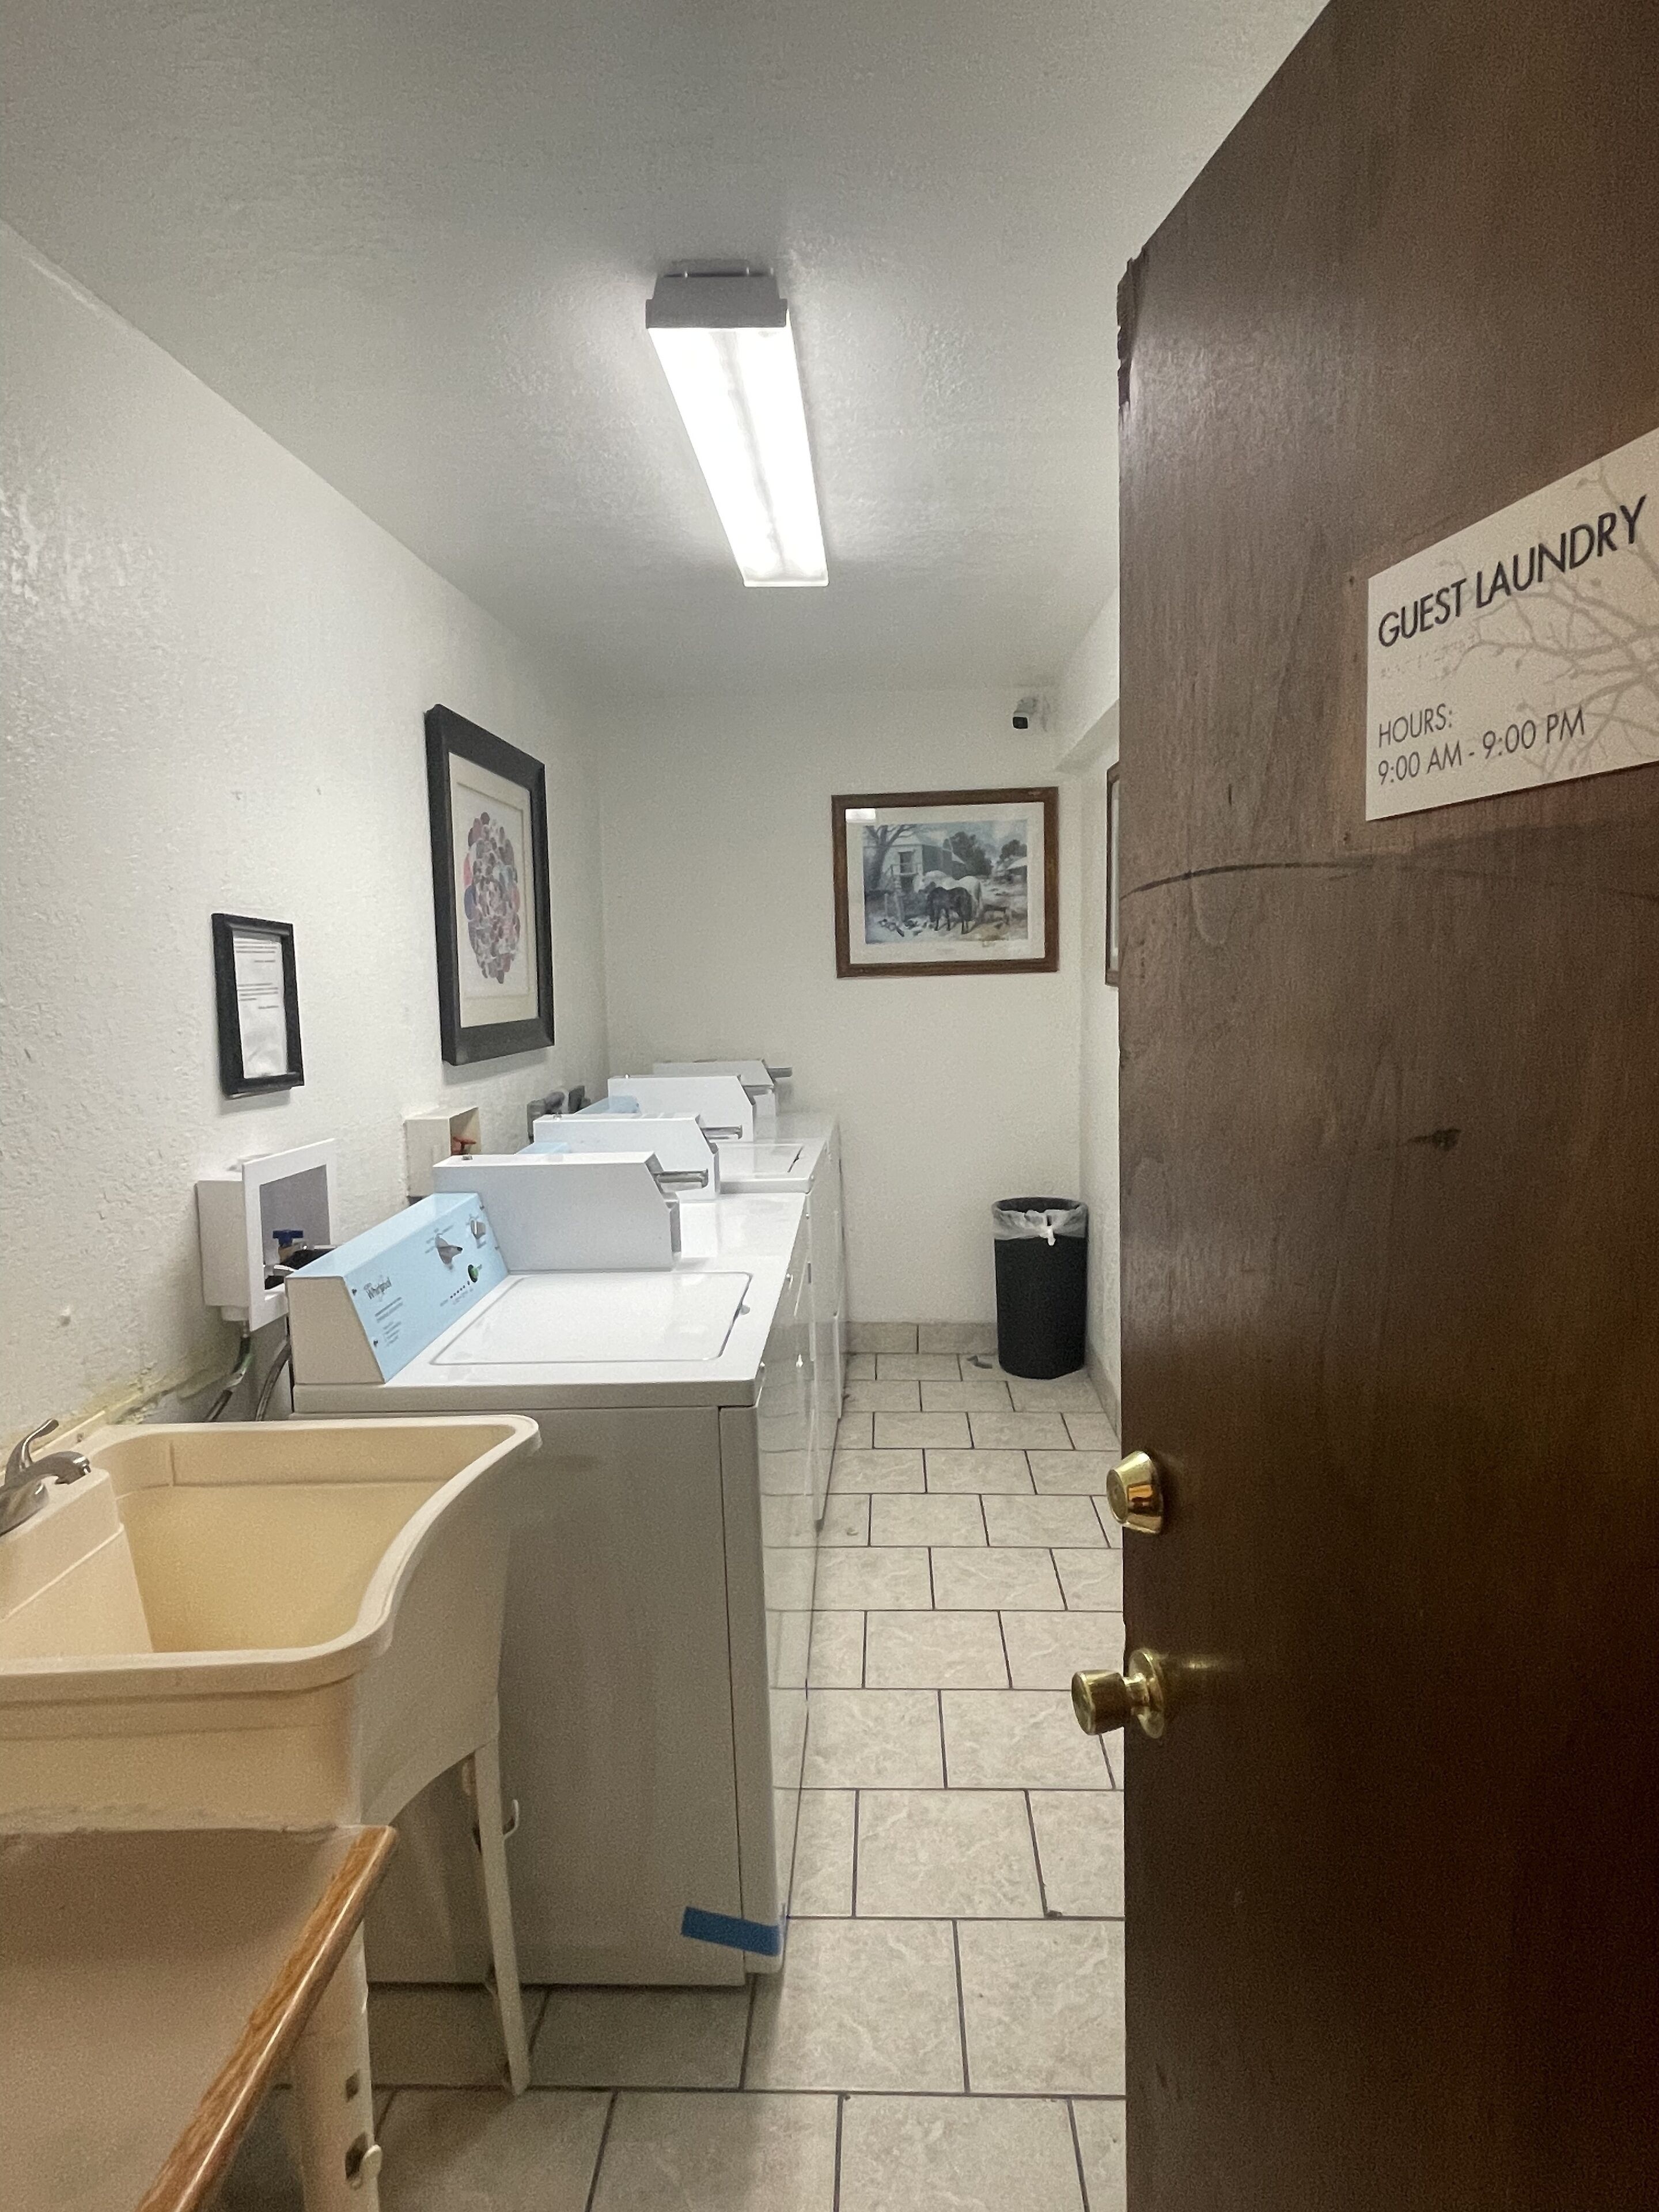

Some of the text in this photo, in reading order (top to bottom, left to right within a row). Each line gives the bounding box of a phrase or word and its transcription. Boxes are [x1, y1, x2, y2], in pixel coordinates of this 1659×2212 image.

[1378, 495, 1647, 647] GUEST LAUNDRY
[1378, 703, 1453, 748] HOURS:
[1378, 755, 1421, 785] 9:00
[1426, 741, 1463, 774] AM
[1482, 718, 1537, 760] 9:00
[1546, 707, 1585, 744] PM
